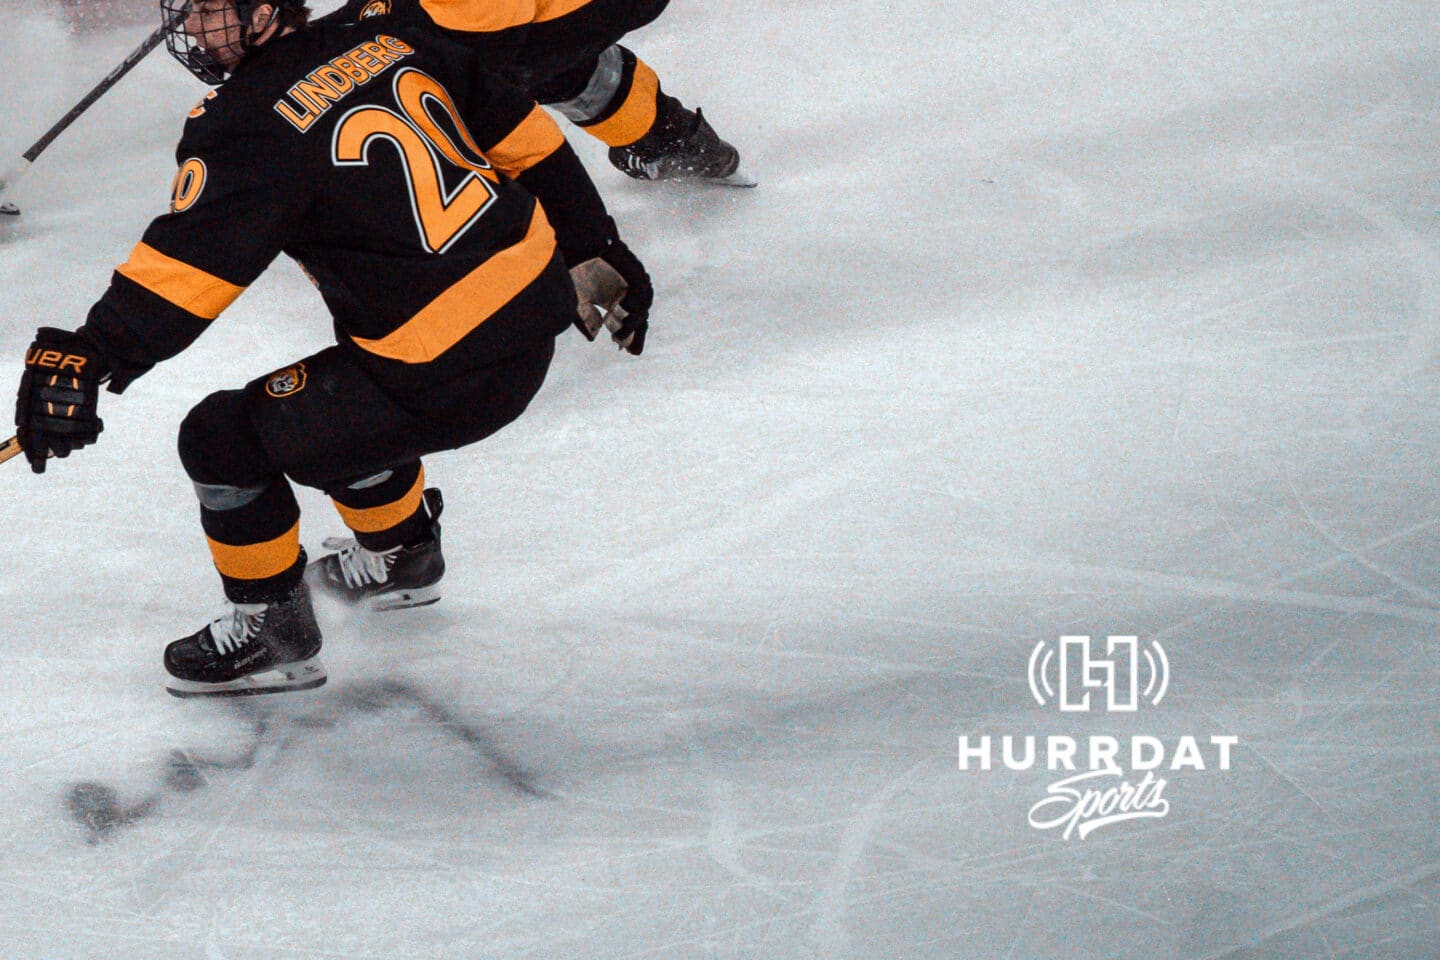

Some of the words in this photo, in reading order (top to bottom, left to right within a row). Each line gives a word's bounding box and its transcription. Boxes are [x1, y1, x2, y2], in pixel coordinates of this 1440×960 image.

[273, 34, 415, 134] LINDBERG
[331, 66, 501, 255] 20
[25, 348, 88, 374] UER
